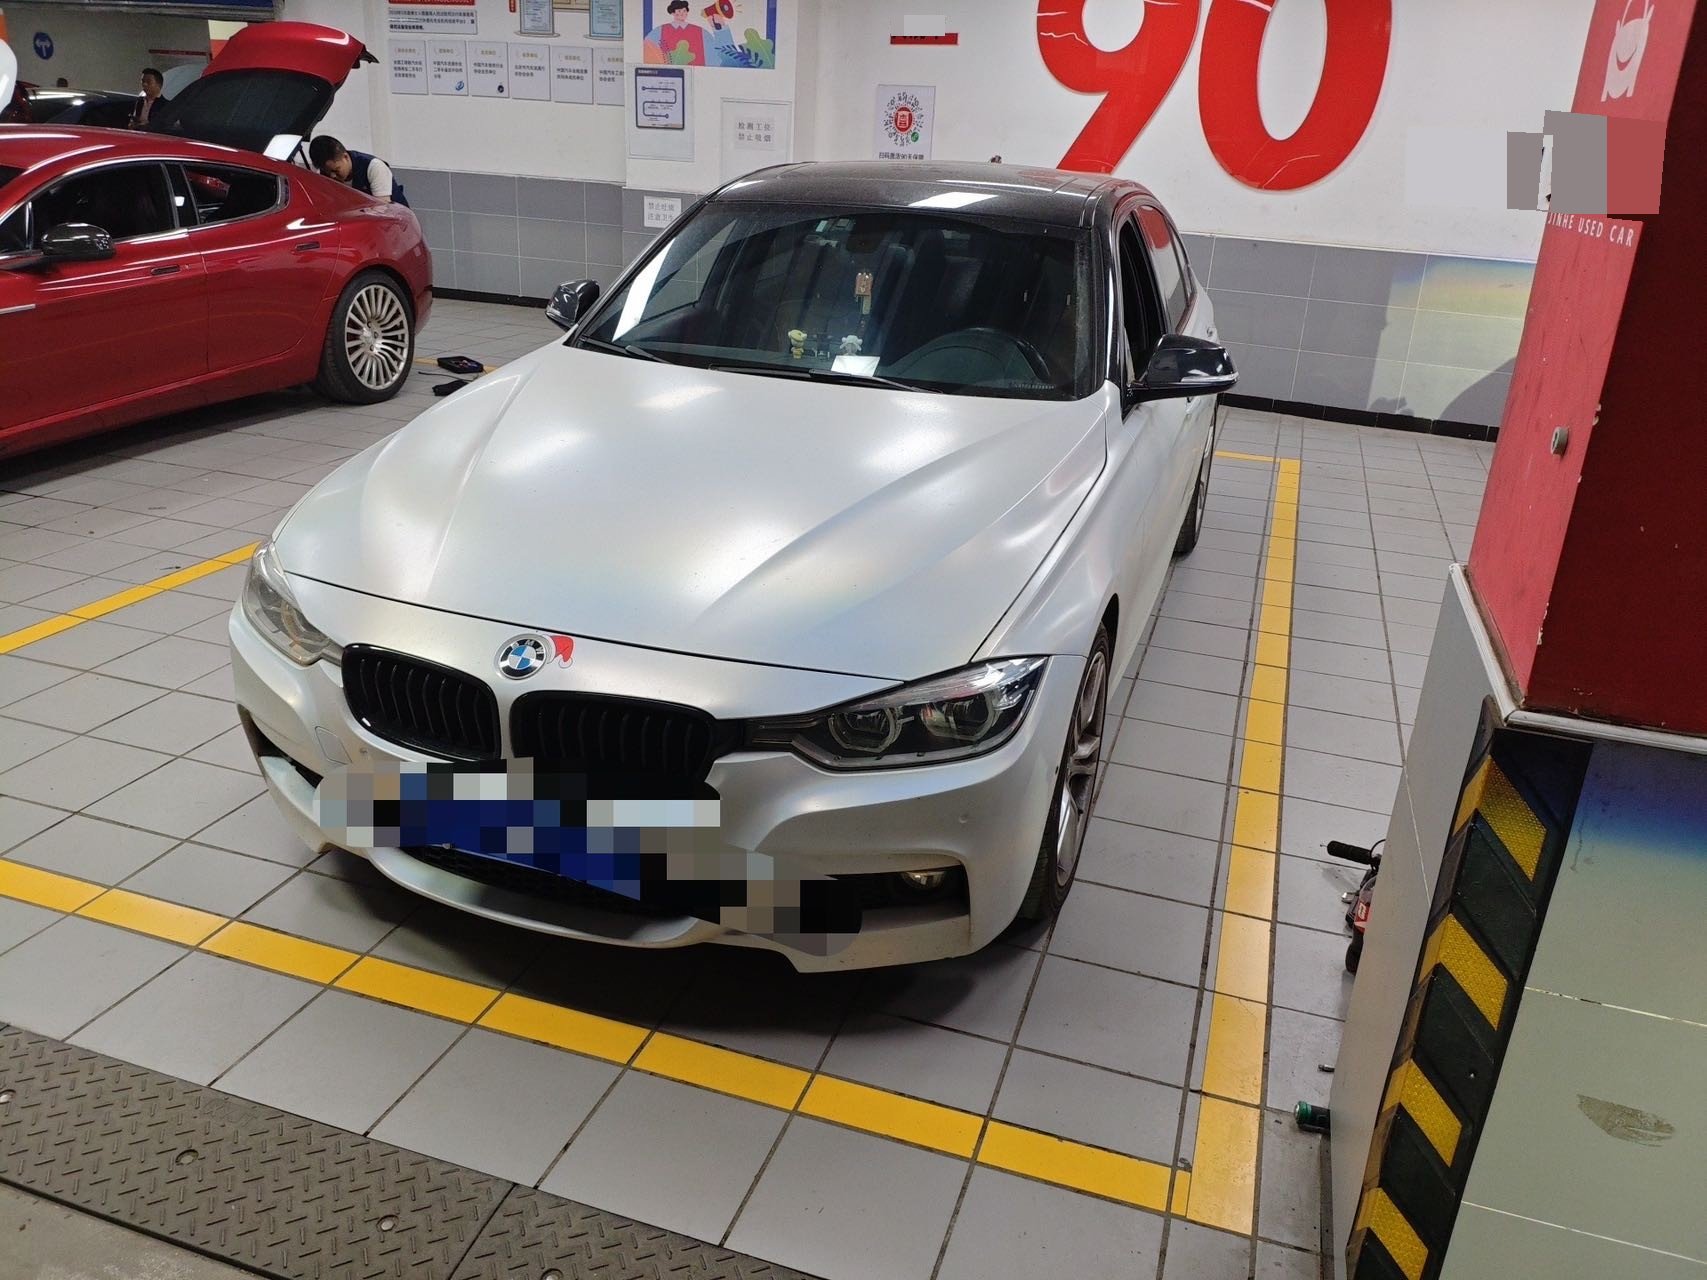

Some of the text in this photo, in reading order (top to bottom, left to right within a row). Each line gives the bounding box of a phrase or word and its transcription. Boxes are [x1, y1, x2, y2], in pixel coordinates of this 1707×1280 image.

[1037, 0, 1393, 191] 90
[1578, 217, 1604, 238] USED
[1609, 225, 1634, 248] CAR
